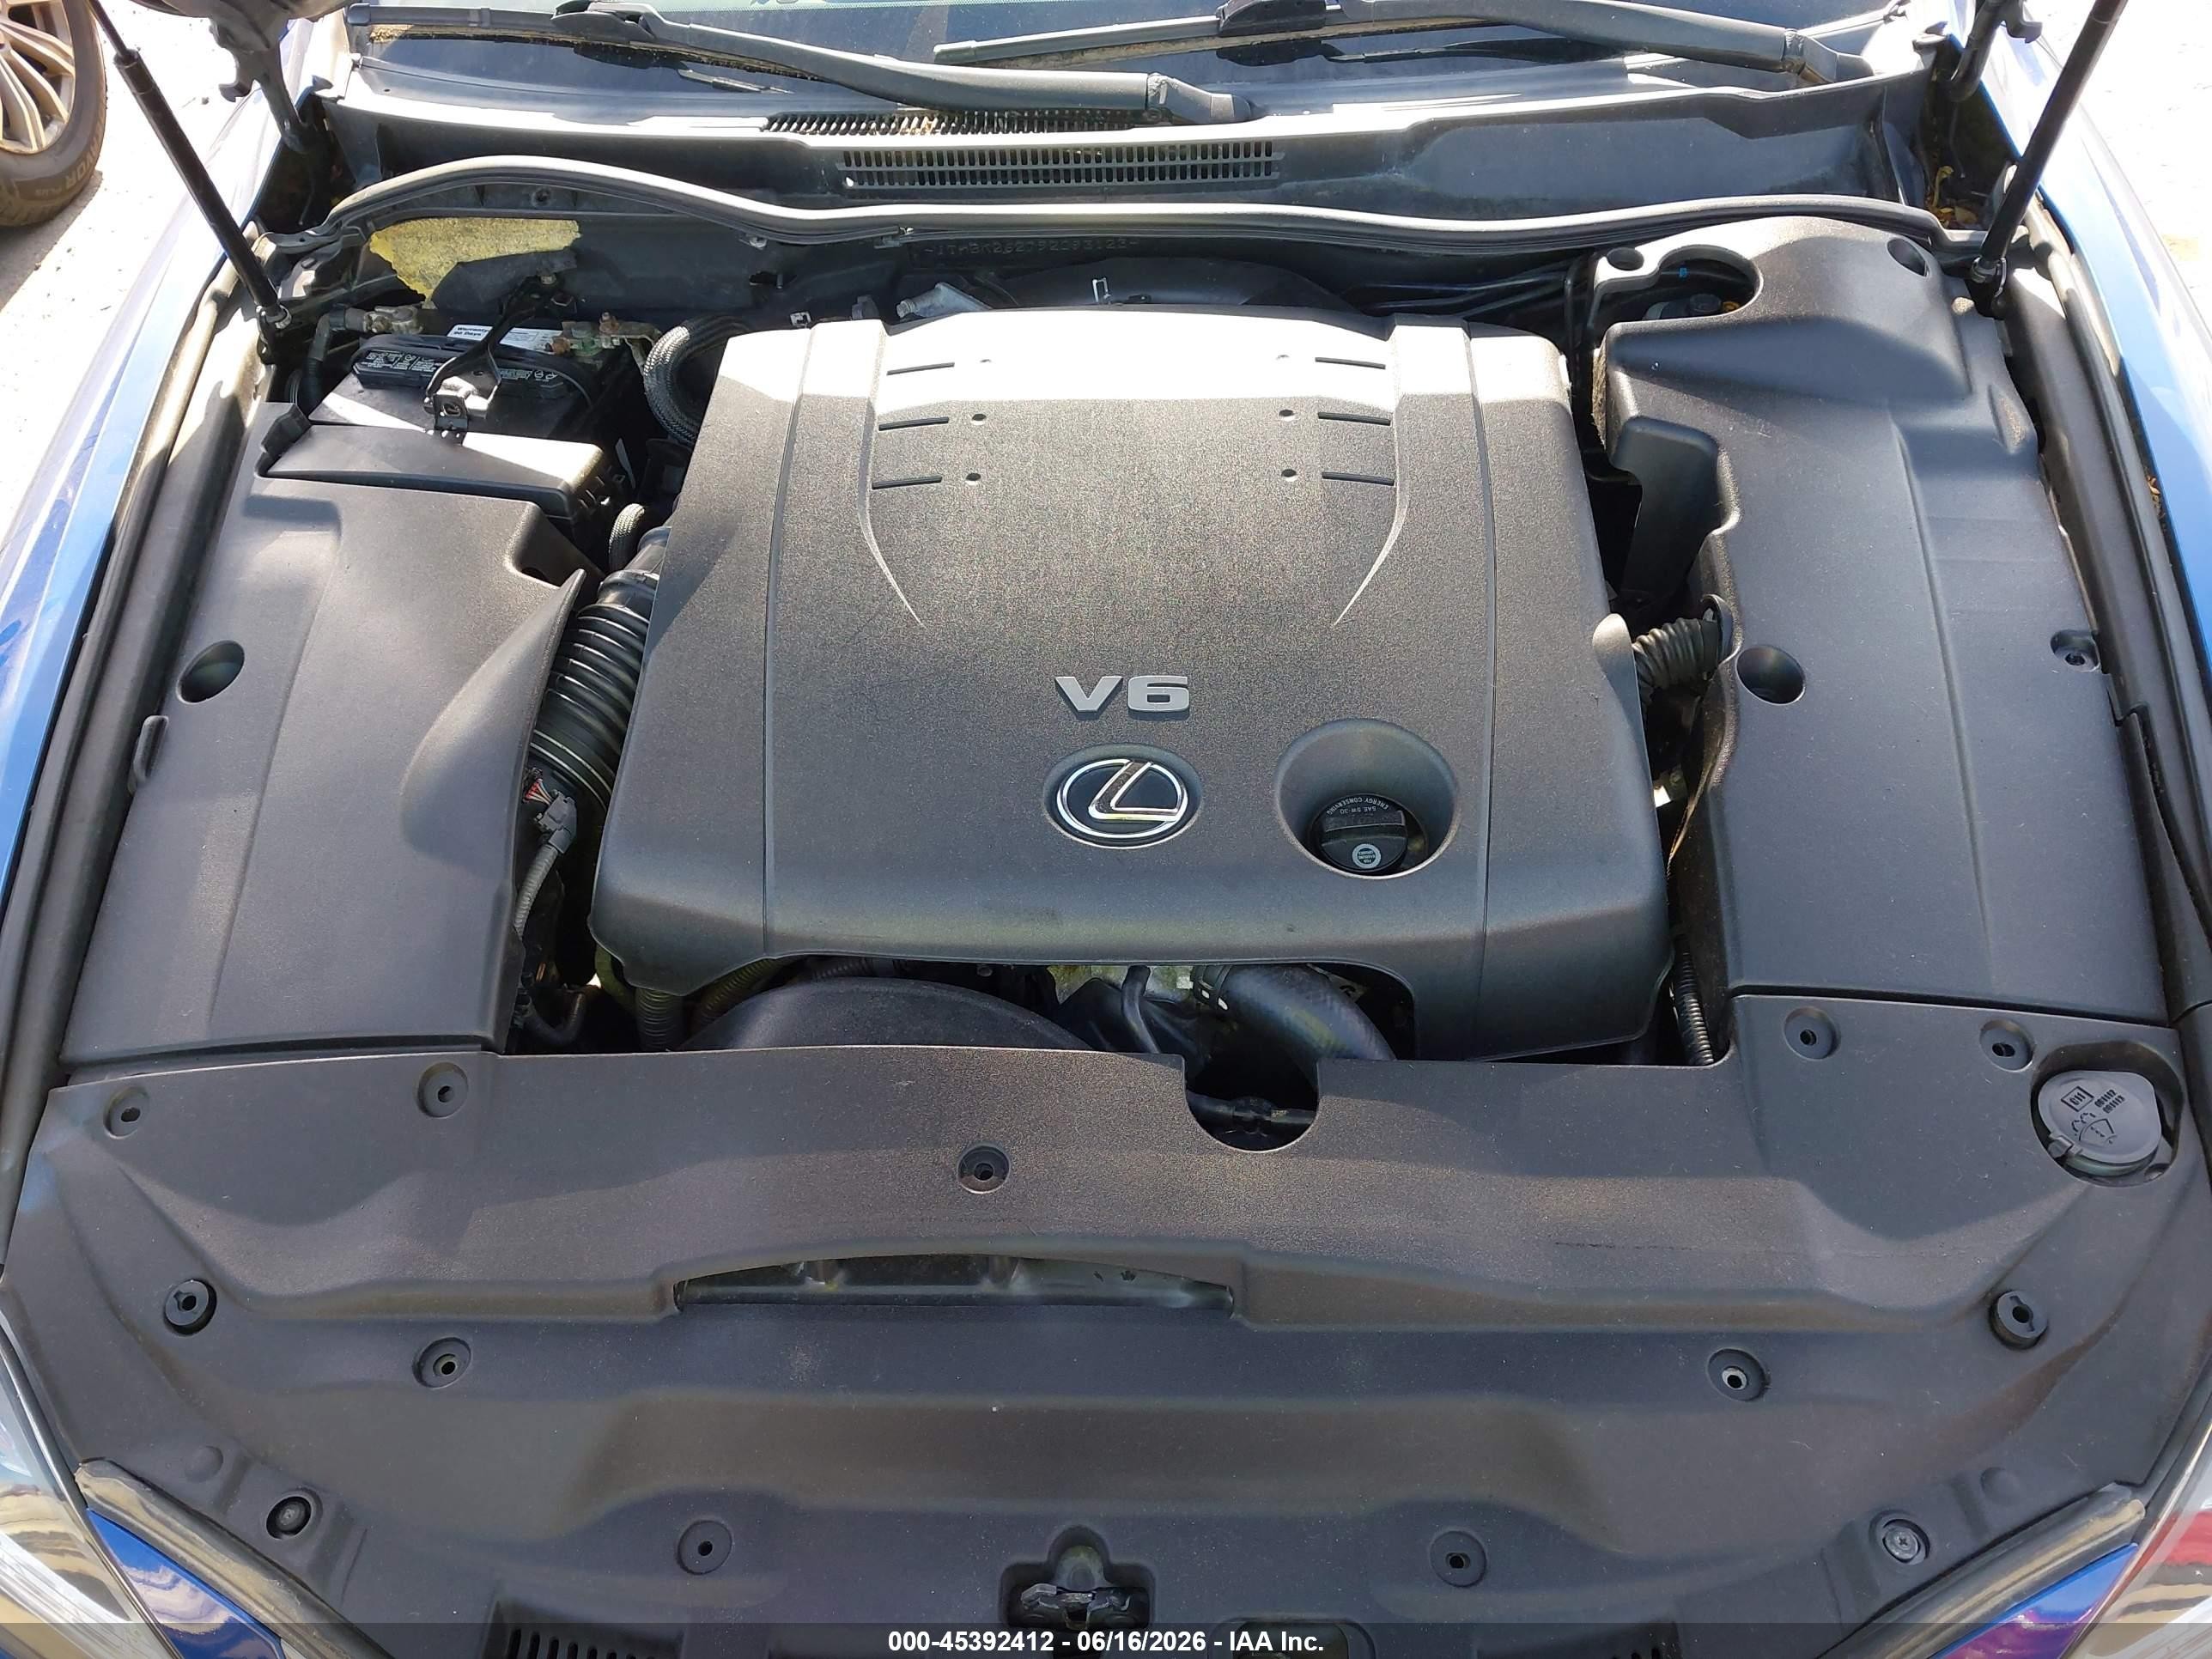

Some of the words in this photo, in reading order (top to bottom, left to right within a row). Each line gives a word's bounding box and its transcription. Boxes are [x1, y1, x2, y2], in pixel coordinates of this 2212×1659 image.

[1055, 675, 1189, 720] V6
[1326, 797, 1363, 815] CONSERVING
[1340, 806, 1361, 815] 5W-30
[1364, 798, 1389, 810] ENERGY
